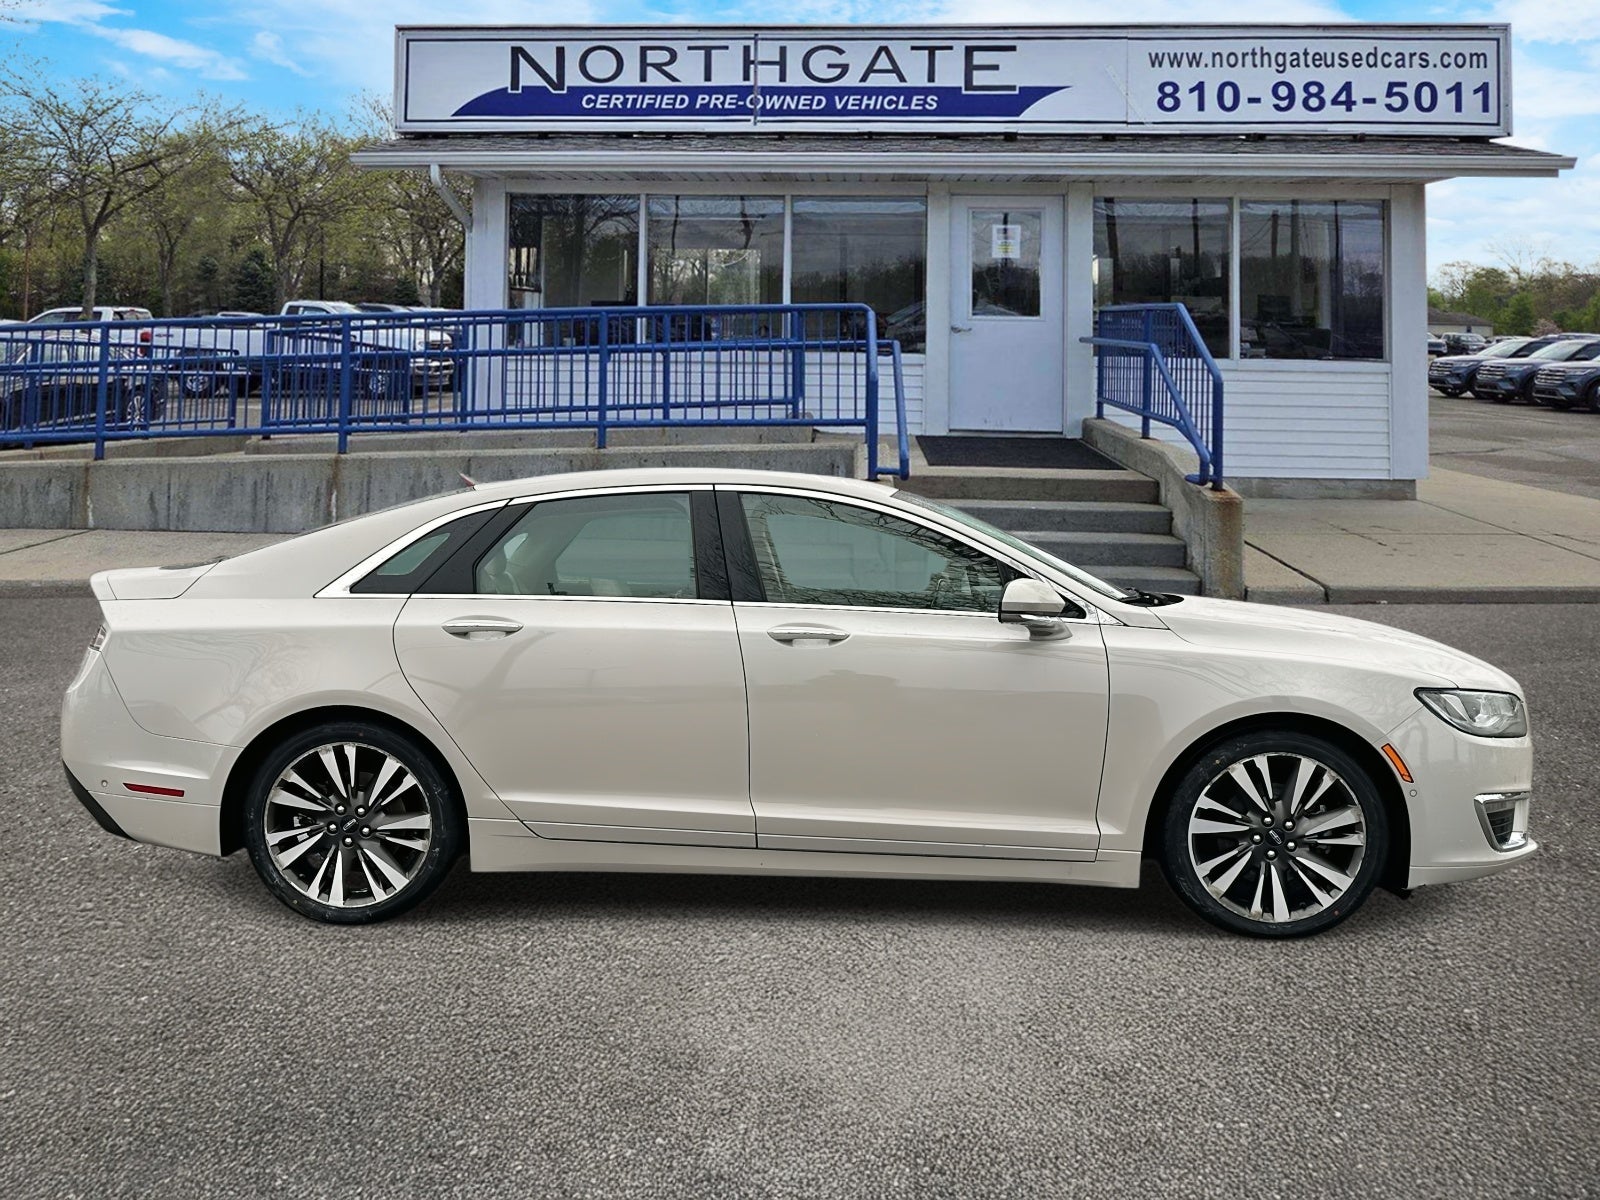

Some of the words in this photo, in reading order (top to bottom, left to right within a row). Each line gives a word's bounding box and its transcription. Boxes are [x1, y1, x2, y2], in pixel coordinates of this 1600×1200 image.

[510, 45, 1017, 93] NORTHGATE
[1148, 47, 1488, 73] www.northgateusedcars.com
[581, 93, 688, 109] CERTIFIED
[695, 93, 826, 110] PRE-OWNED
[834, 94, 939, 111] VEHICLES
[1156, 80, 1490, 112] 810-984-5011
